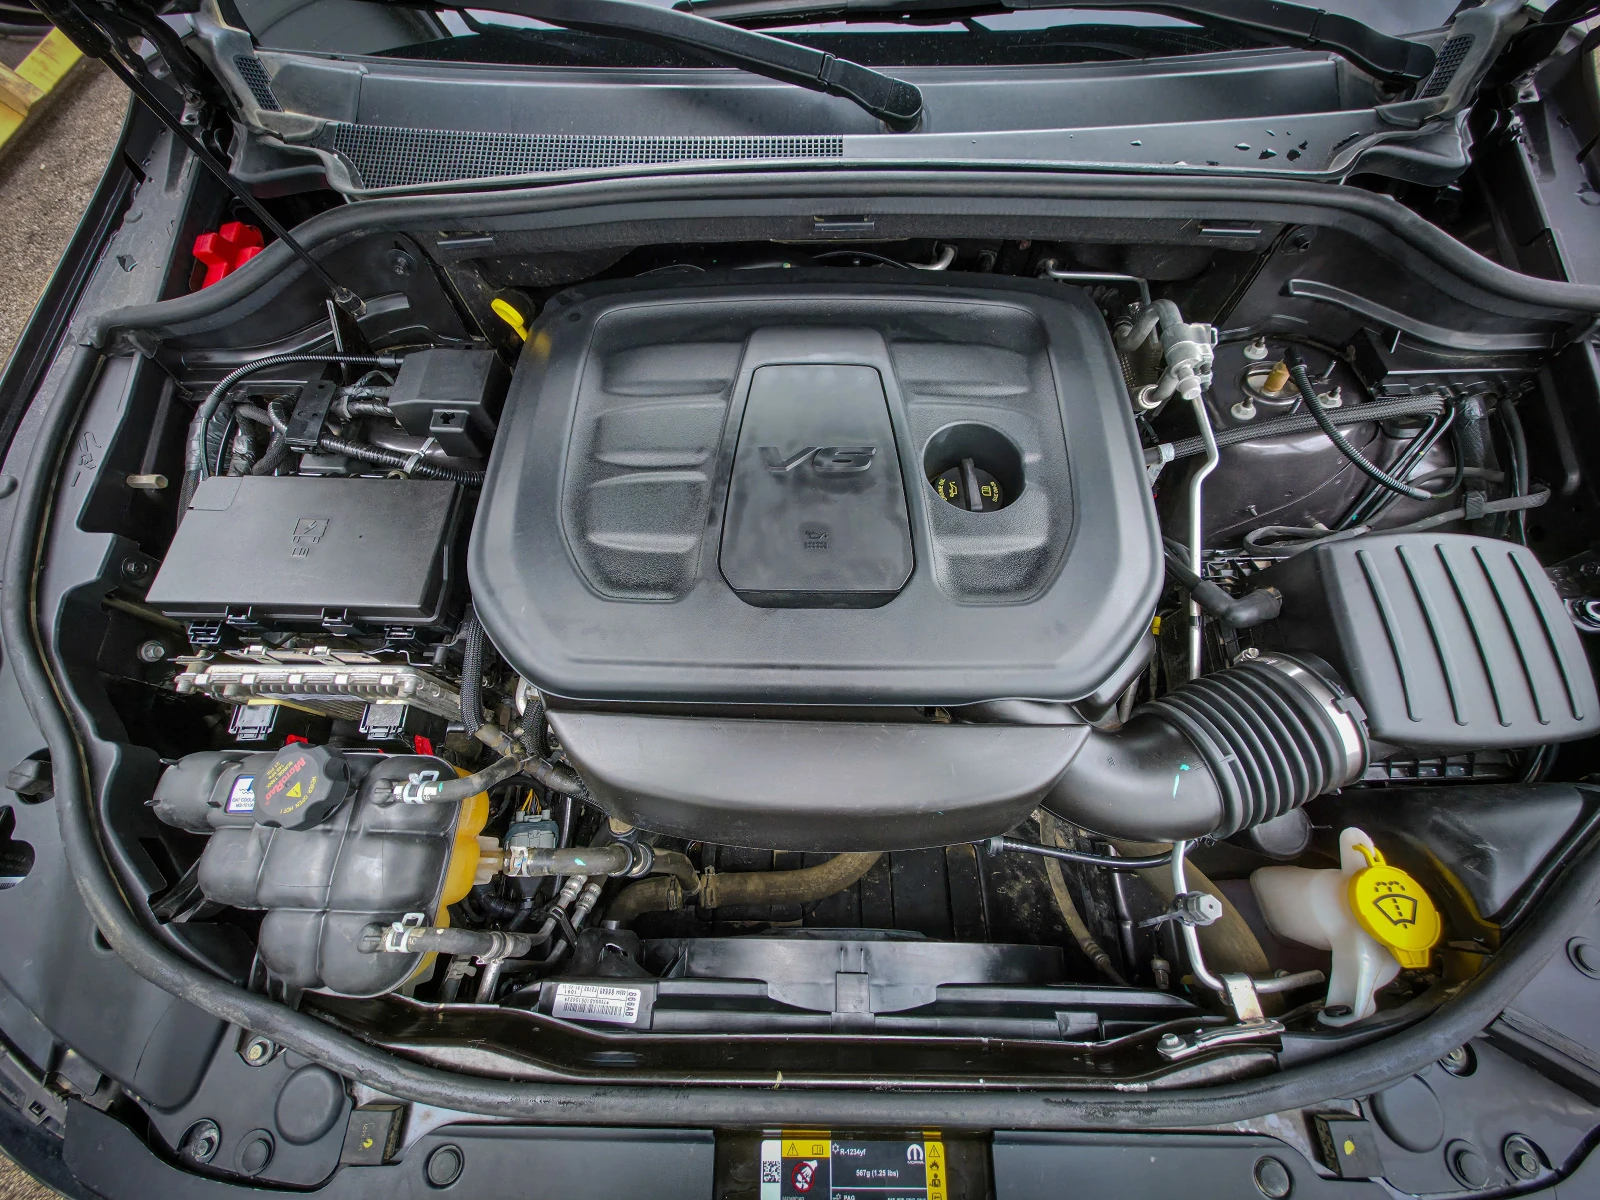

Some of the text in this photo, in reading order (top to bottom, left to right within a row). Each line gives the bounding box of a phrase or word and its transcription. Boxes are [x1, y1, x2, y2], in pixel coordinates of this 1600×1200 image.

[758, 446, 877, 473] V6
[267, 760, 294, 789] SURGE TANK
[308, 776, 317, 794] NEVER
[295, 795, 309, 809] OPEN
[840, 1148, 866, 1156] R-1234yf
[856, 1169, 871, 1179] 567g
[887, 1169, 899, 1179] lbs)
